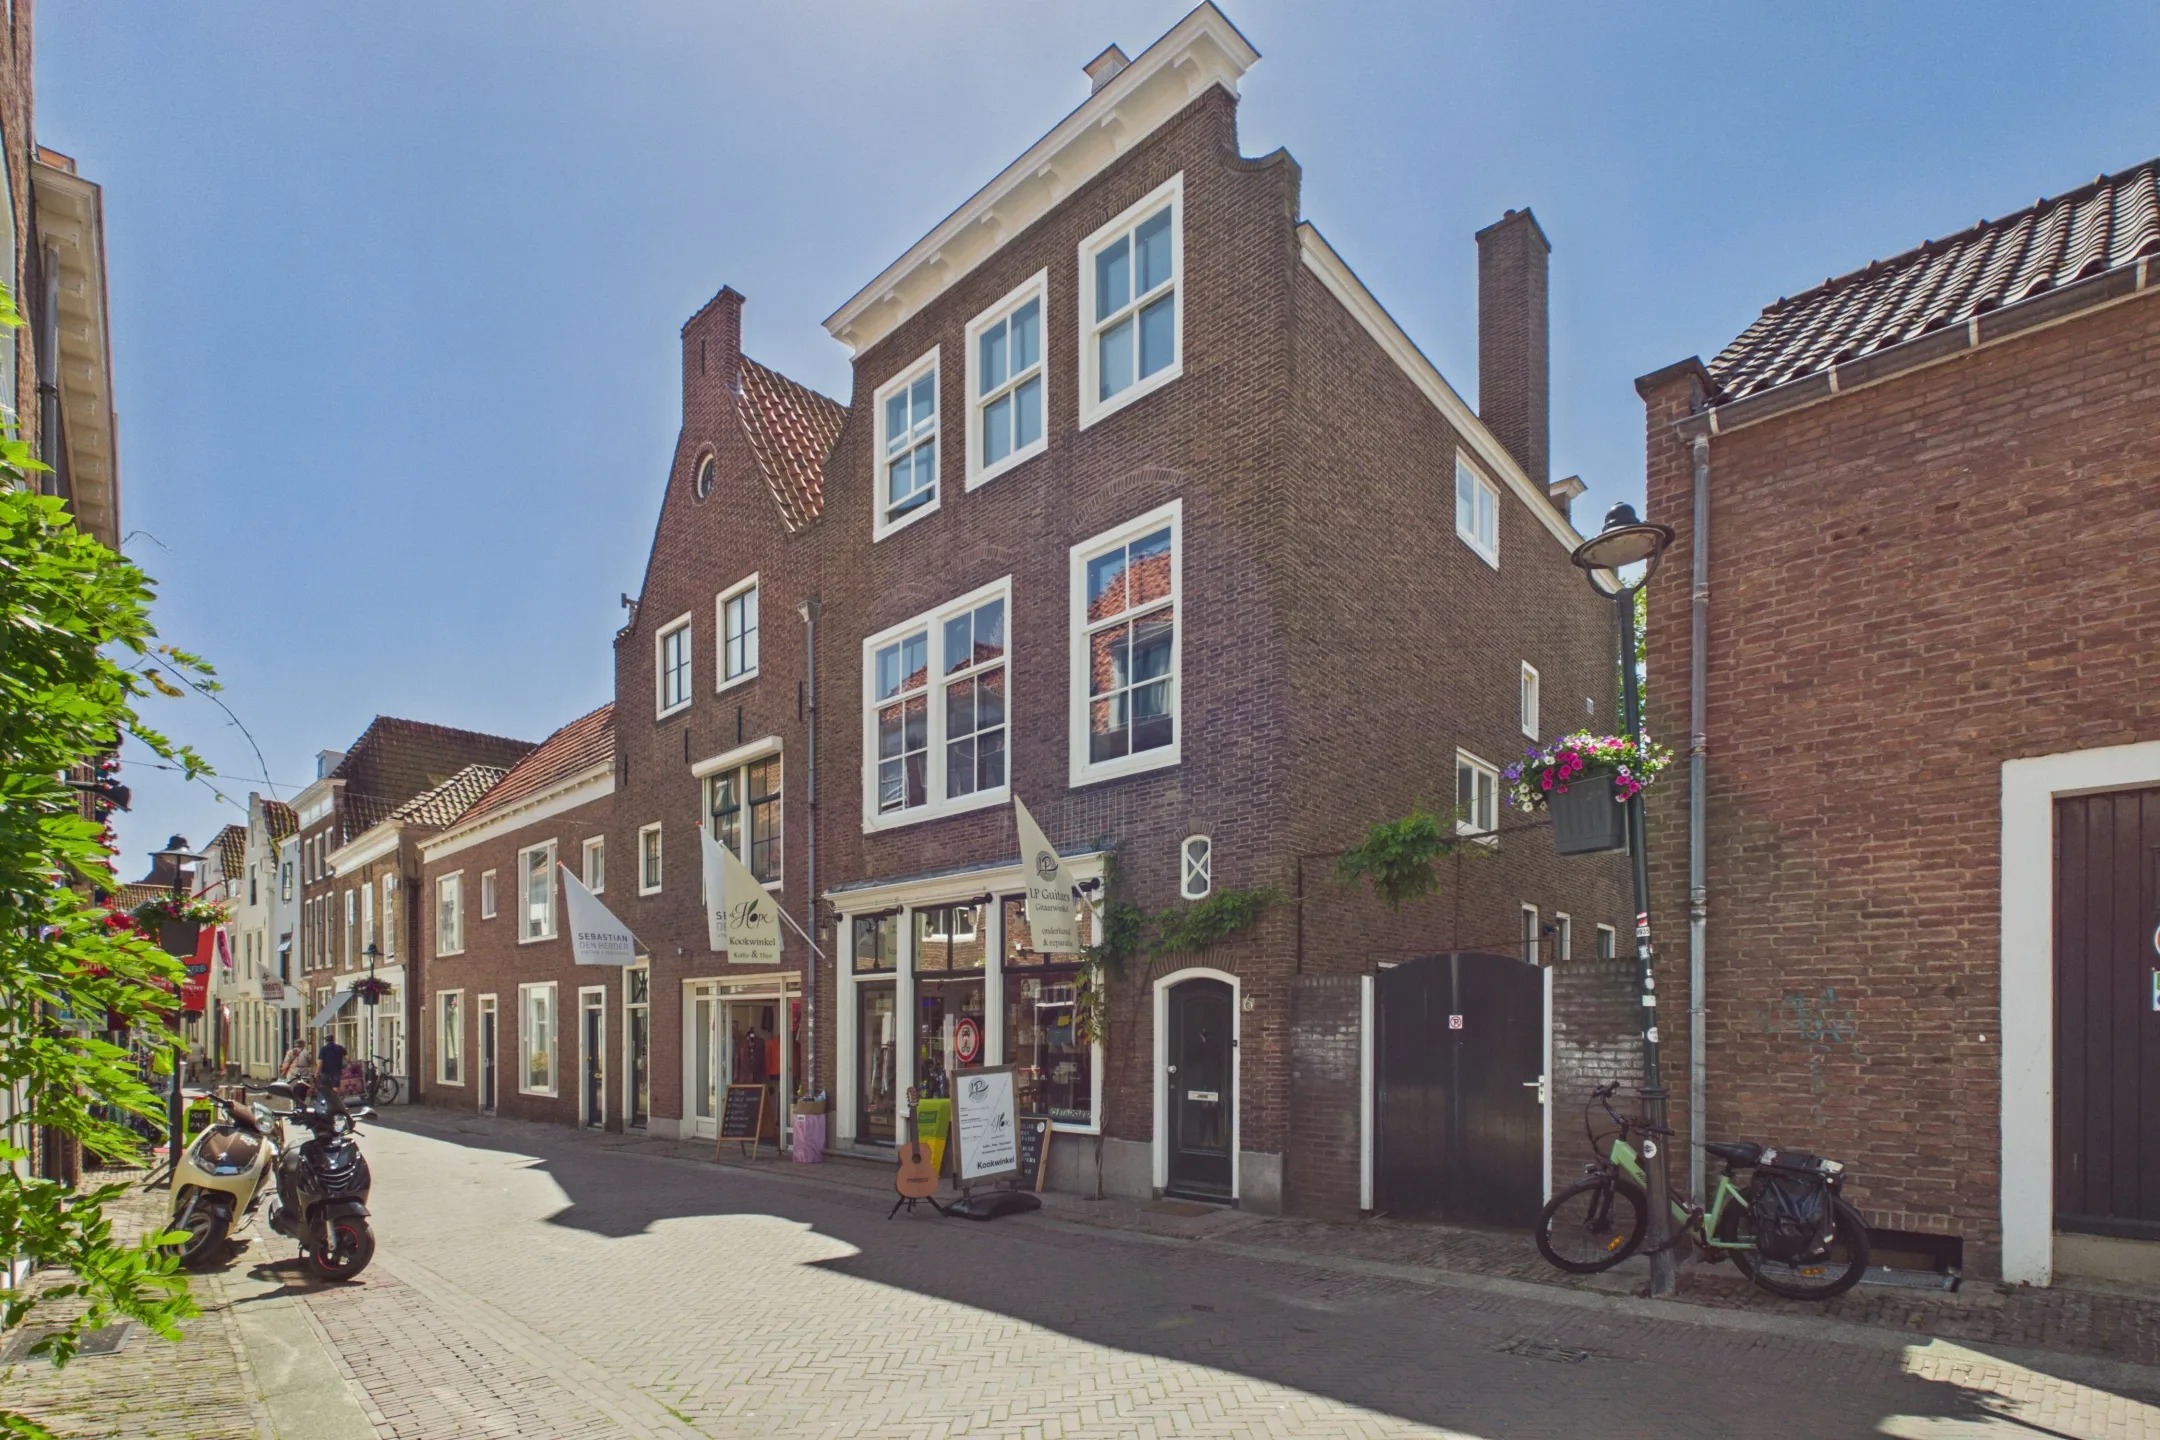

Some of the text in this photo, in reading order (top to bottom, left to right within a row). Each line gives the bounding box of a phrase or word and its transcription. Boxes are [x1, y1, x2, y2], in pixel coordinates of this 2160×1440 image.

[1029, 887, 1071, 902] LP Guitars
[577, 932, 629, 943] SEBASTIAN
[729, 936, 776, 946] Kookwinkel
[579, 941, 597, 949] DEN
[751, 950, 758, 959] &
[1243, 993, 1254, 1013] 6
[976, 1155, 1016, 1170] Kookwinkel
